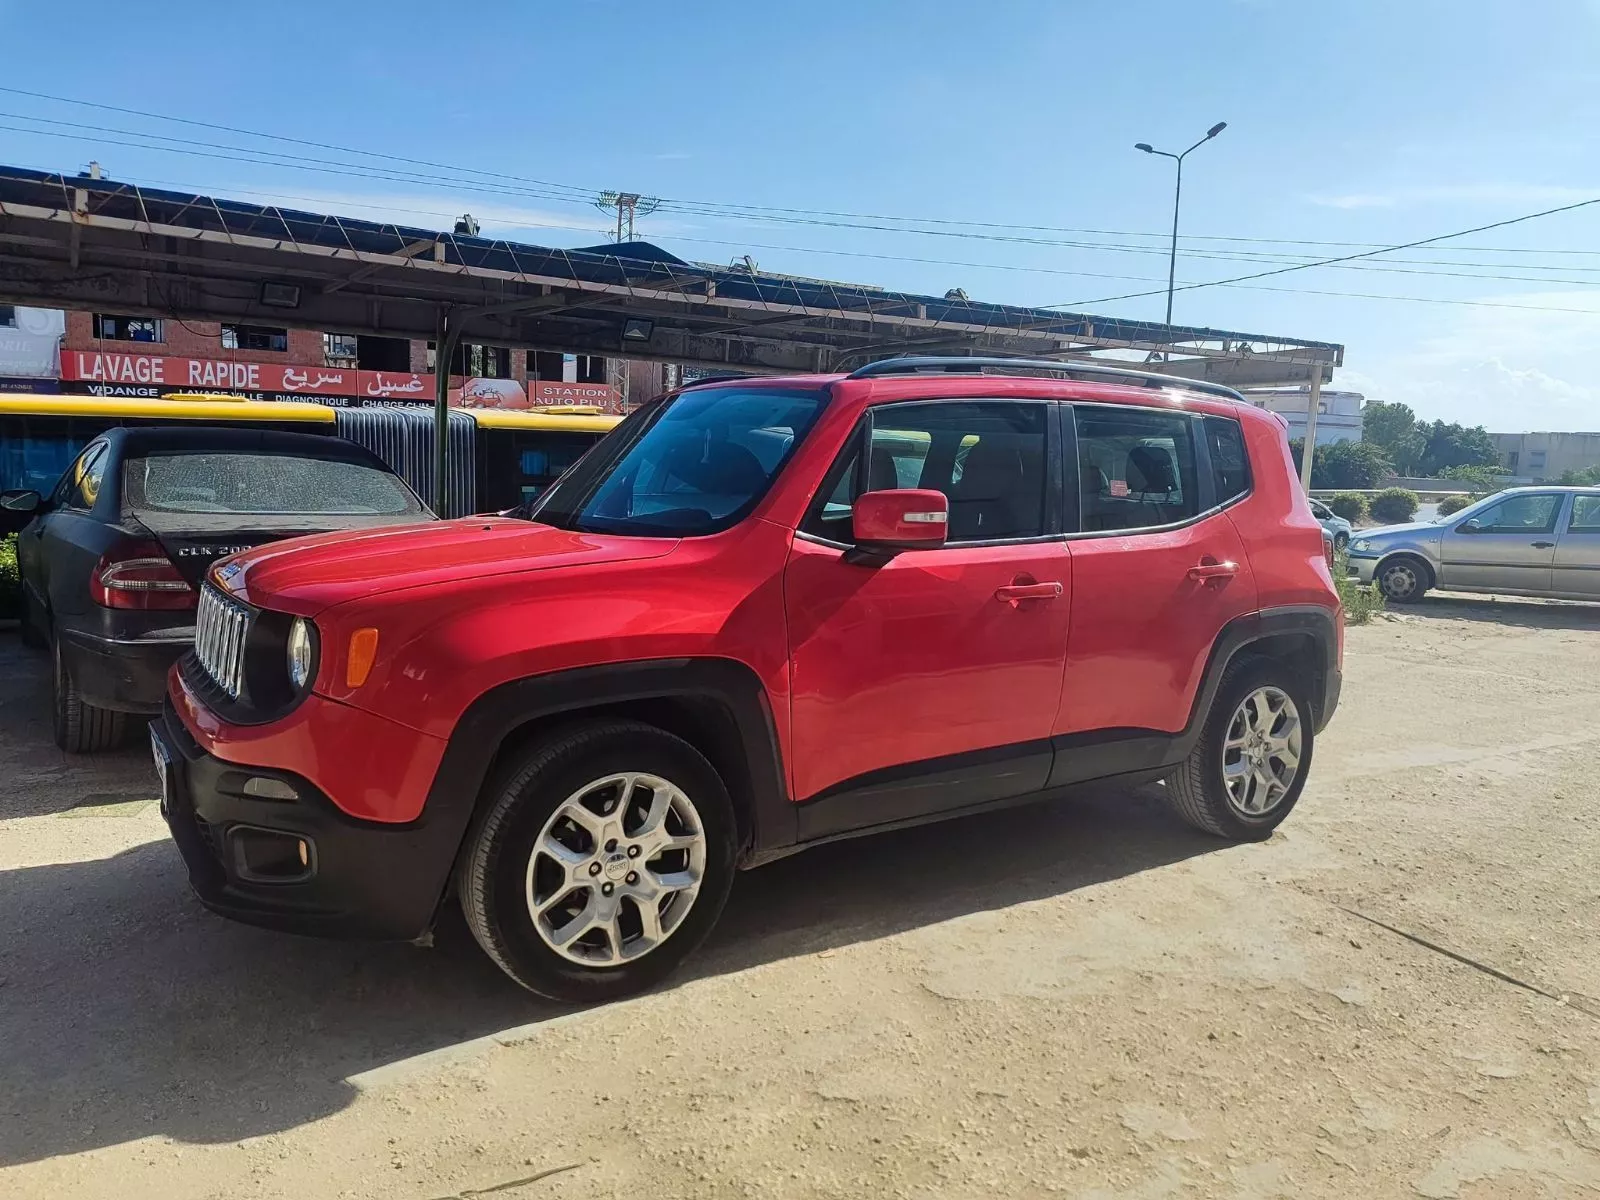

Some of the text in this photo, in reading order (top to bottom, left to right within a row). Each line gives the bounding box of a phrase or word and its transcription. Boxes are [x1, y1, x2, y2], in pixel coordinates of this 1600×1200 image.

[79, 354, 164, 382] LAVAGE
[188, 361, 260, 389] RAPIDE
[282, 367, 424, 397] غسيل سريع
[87, 385, 158, 397] VIDANGE
[275, 394, 349, 407] DIAGNOSTIQUE
[362, 400, 404, 408] CHARGE
[543, 387, 607, 397] STATION
[533, 397, 575, 406] AUTO
[179, 547, 212, 556] CLK
